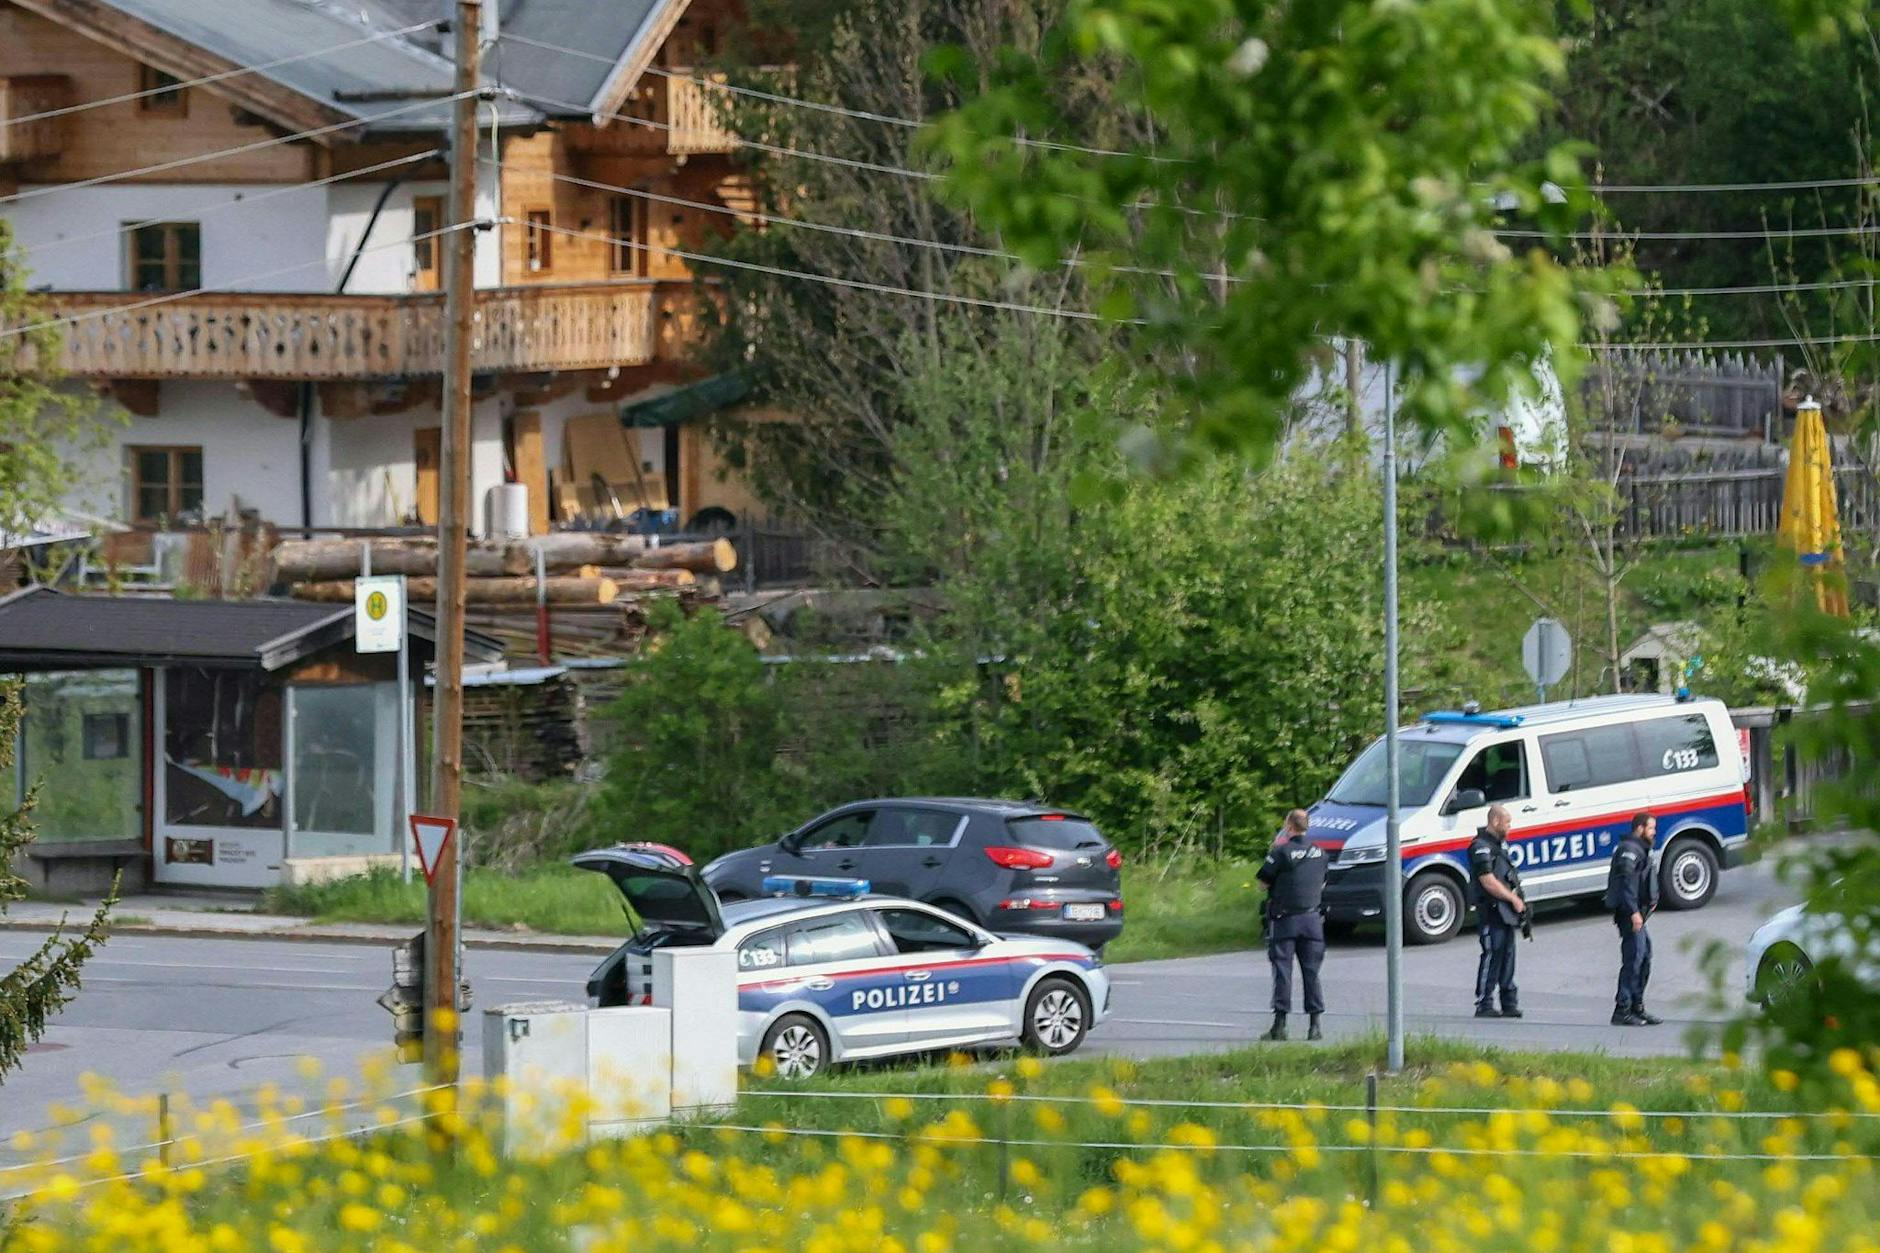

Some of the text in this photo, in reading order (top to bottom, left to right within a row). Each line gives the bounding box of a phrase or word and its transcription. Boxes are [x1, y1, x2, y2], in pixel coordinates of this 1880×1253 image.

[1673, 748, 1699, 769] 133
[1308, 816, 1357, 831] OLIZEI
[1507, 832, 1595, 868] OLIZEI
[752, 948, 777, 966] 133
[852, 981, 945, 1010] POLIZEI
